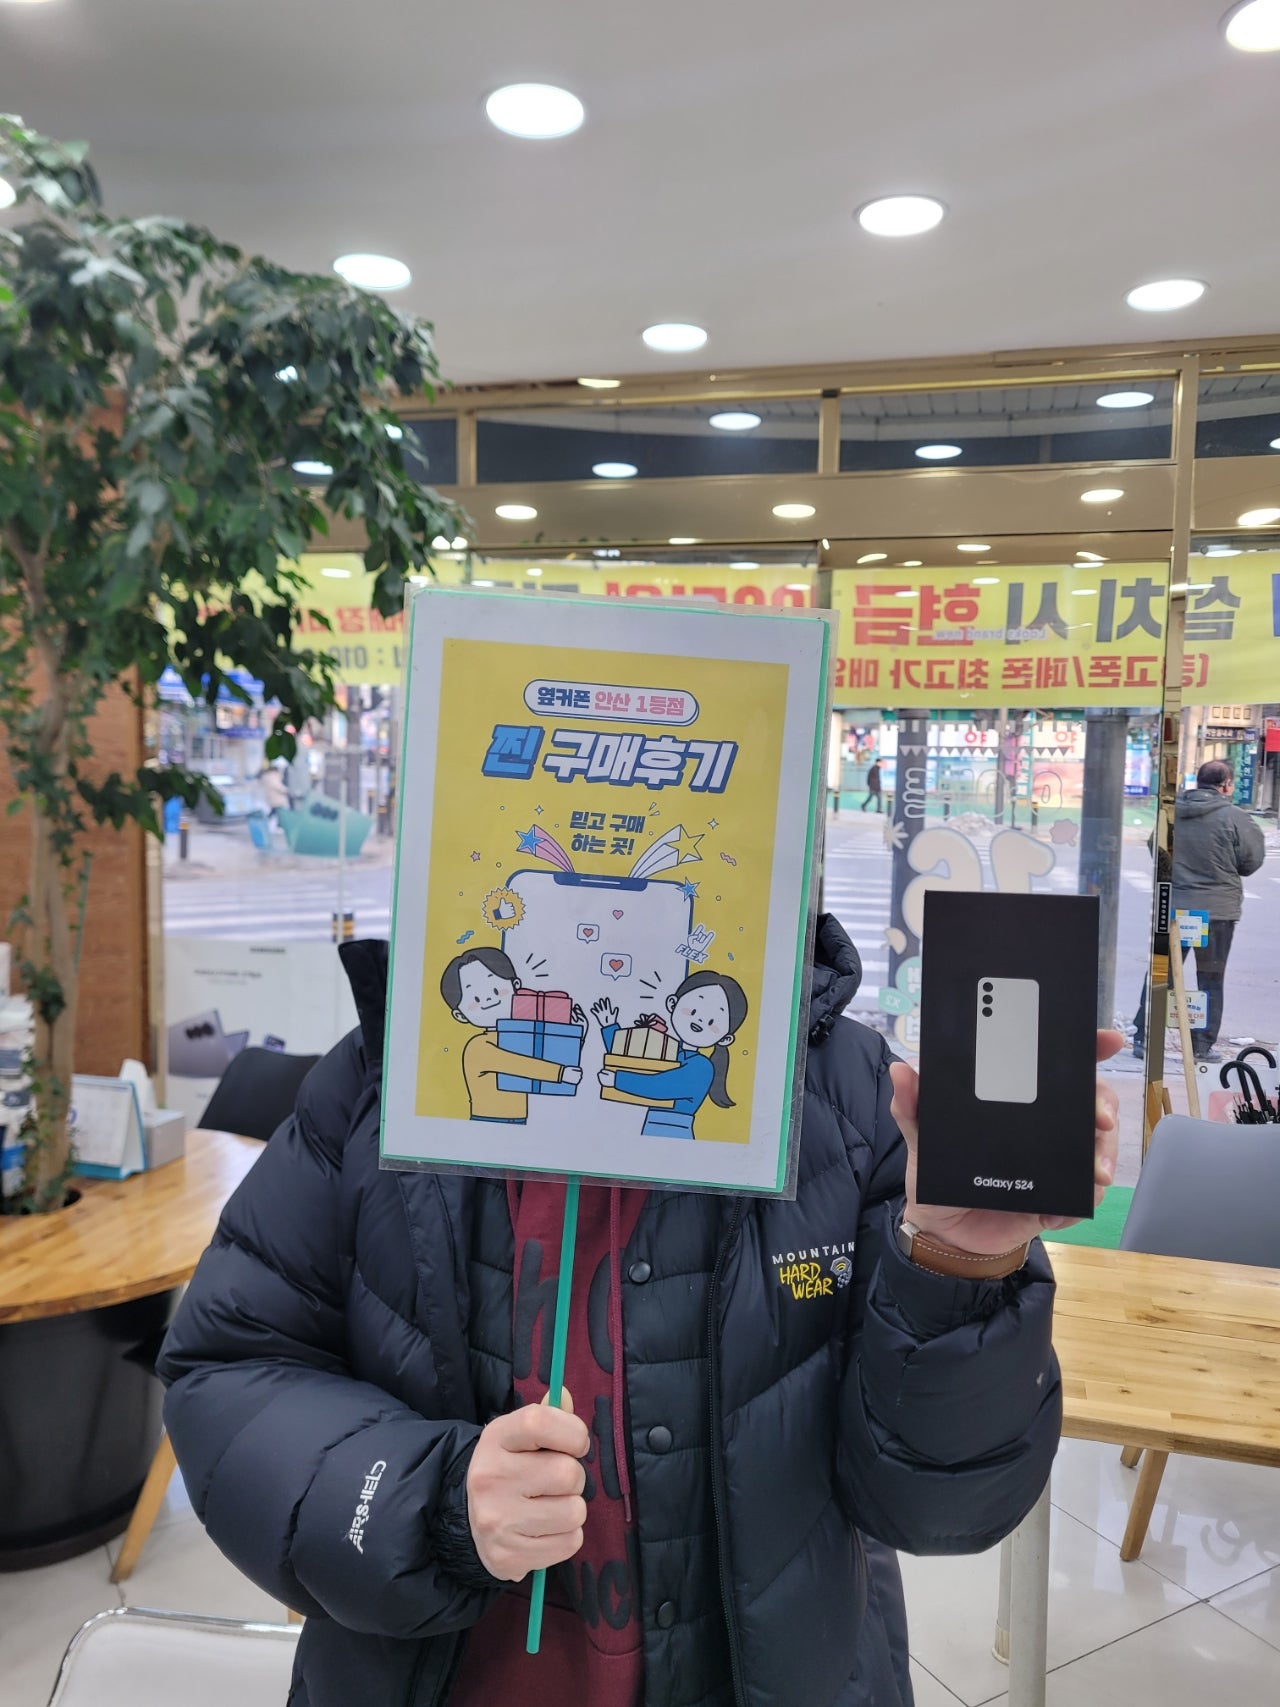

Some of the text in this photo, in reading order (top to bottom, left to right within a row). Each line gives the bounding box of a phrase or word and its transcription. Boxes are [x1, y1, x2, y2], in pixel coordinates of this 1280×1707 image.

[538, 686, 685, 716] 옆커폰 안산 1등점
[482, 724, 738, 794] 찐 구매후기
[570, 811, 646, 834] 믿고 구매
[570, 833, 635, 856] 하는 곳!
[675, 943, 709, 964] FLEX
[973, 1176, 1034, 1191] Galaxy S24
[772, 1241, 855, 1265] MOUNTAIN
[779, 1262, 821, 1285] HARD
[791, 1278, 834, 1300] WEAR
